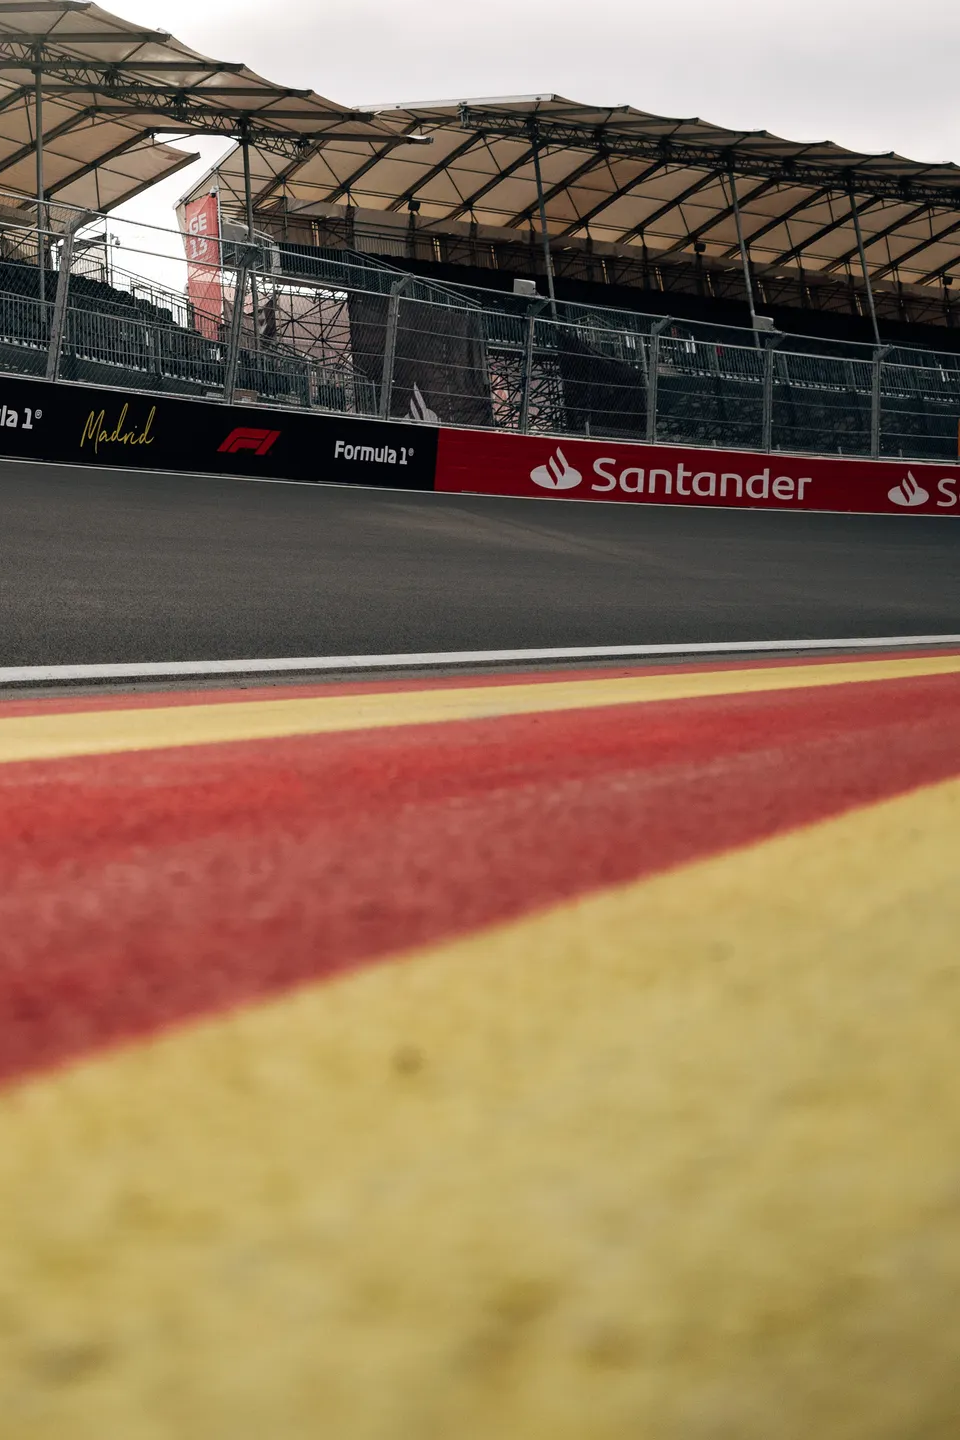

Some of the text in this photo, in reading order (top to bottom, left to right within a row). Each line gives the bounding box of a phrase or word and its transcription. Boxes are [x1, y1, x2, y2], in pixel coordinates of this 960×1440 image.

[80, 403, 156, 454] Madrid
[334, 440, 397, 464] Formula
[591, 456, 813, 501] Santander
[936, 478, 960, 507] S
